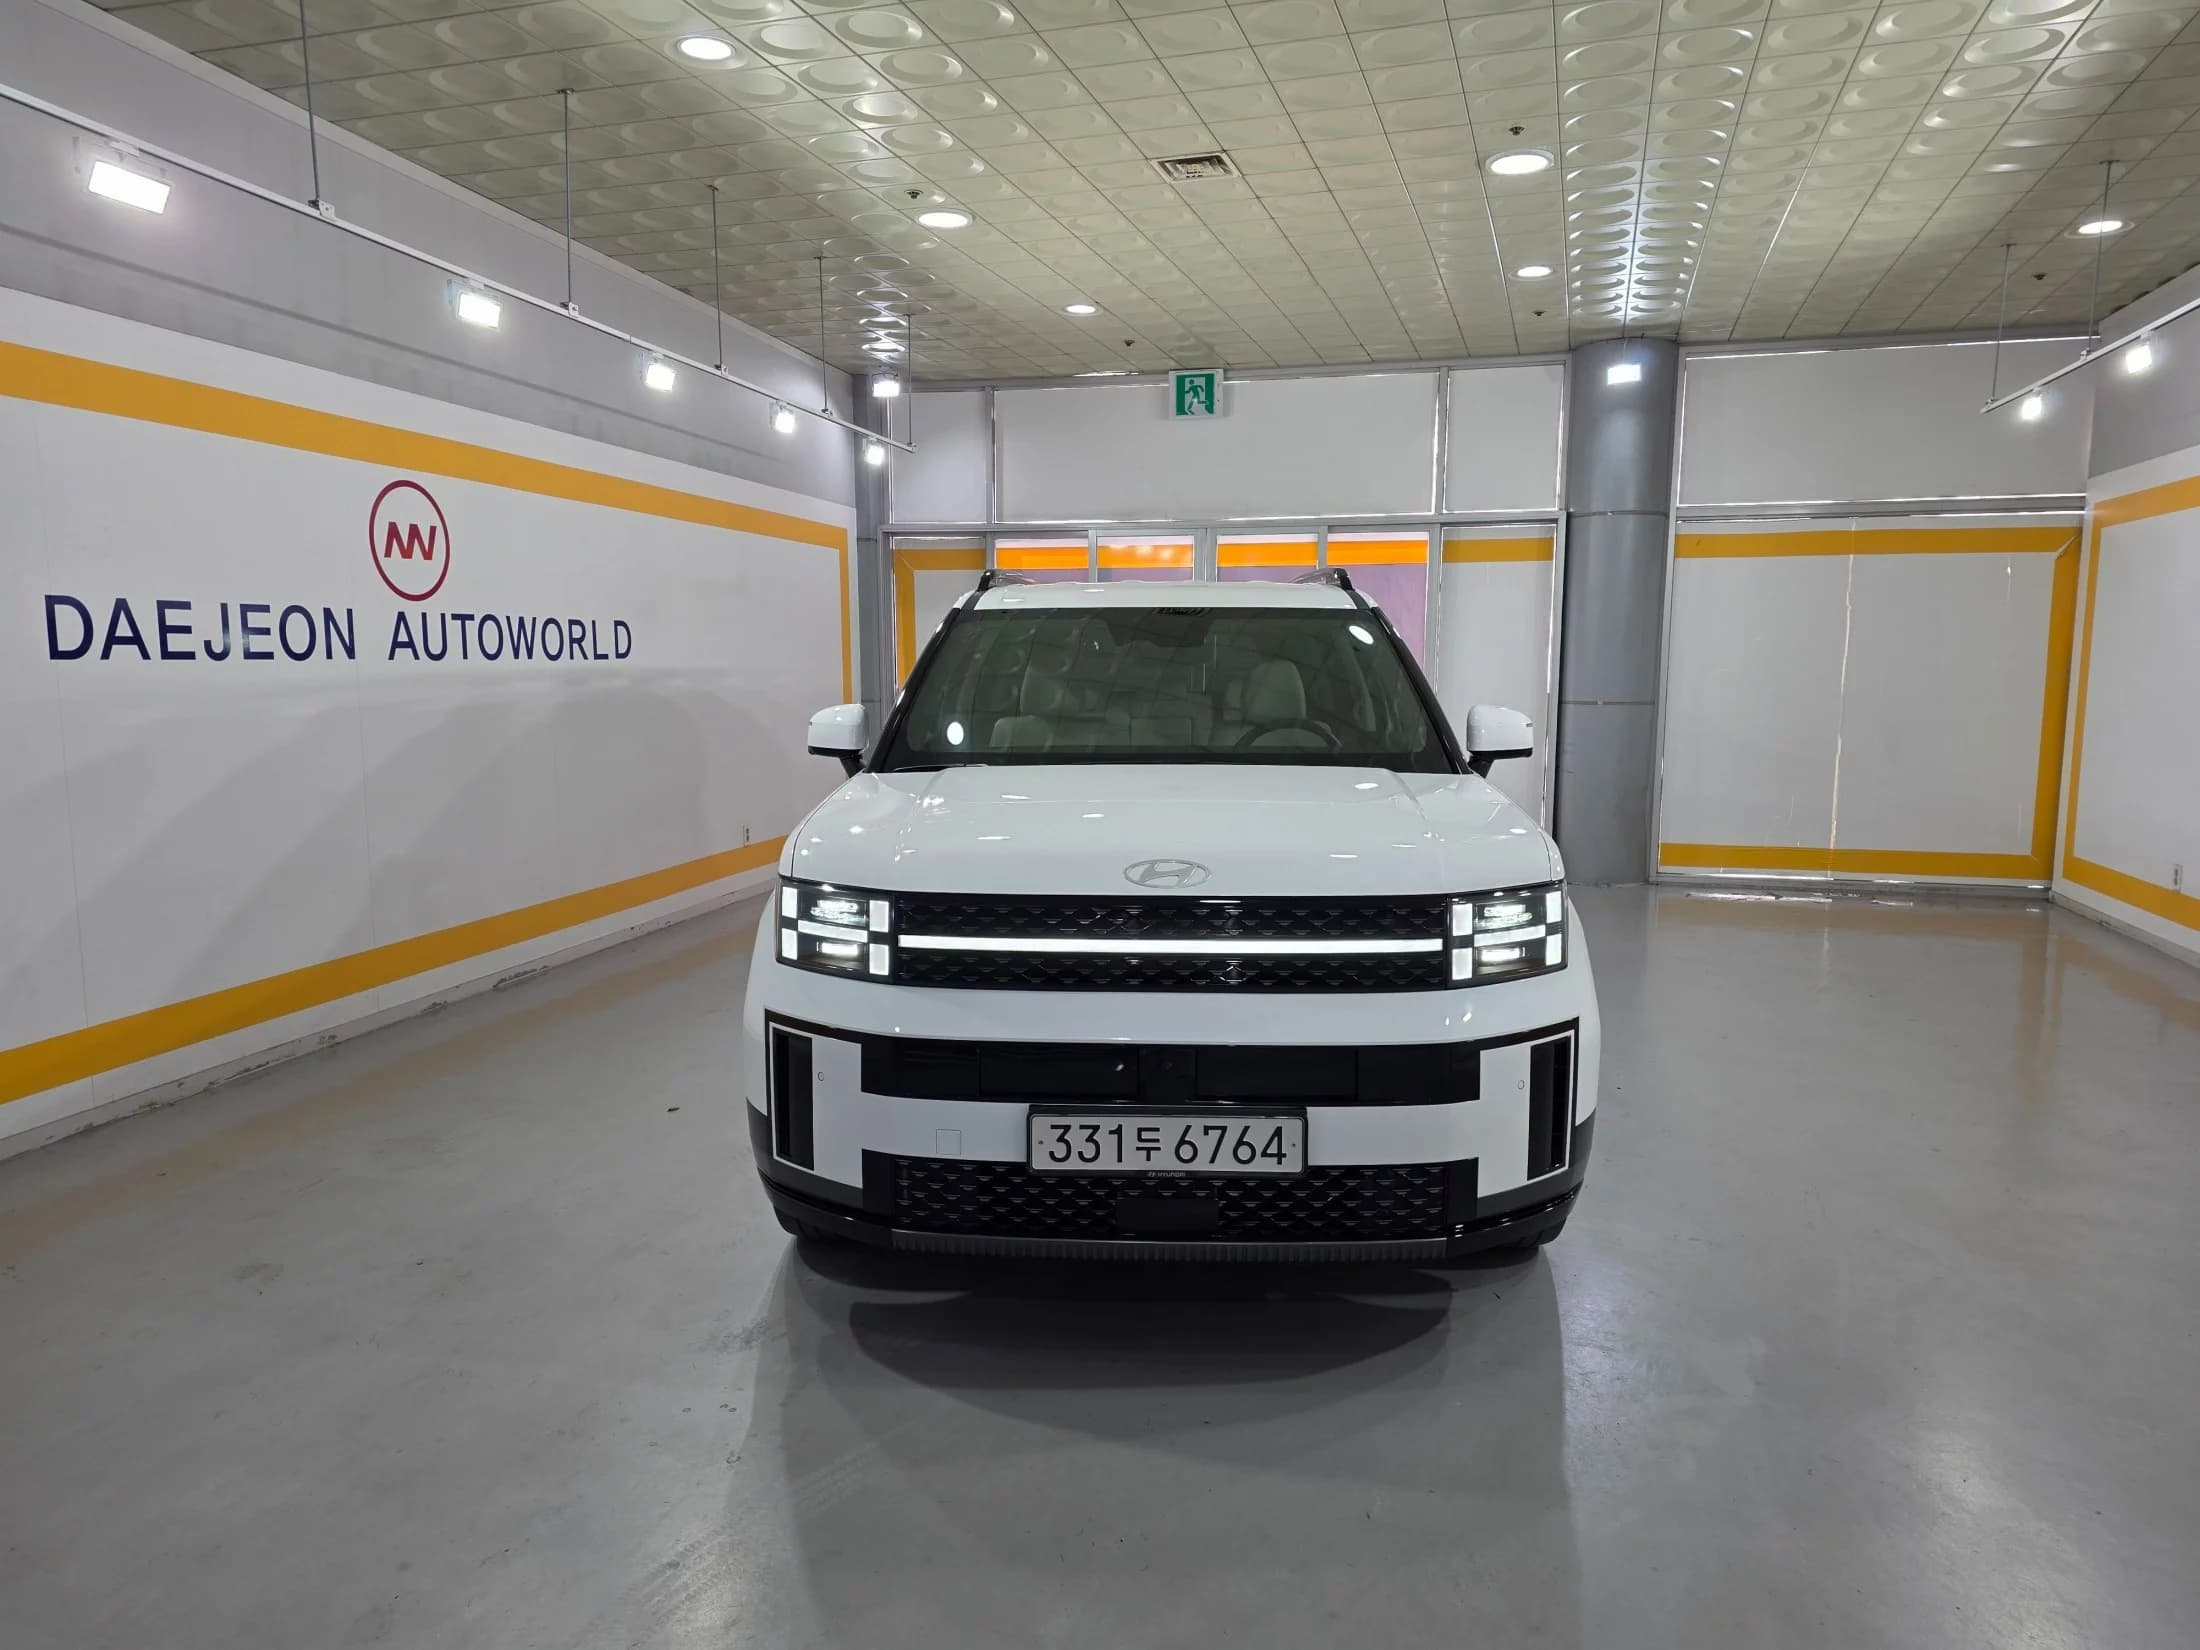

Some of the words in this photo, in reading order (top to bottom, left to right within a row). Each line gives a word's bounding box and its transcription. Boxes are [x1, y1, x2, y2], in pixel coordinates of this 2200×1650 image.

[44, 594, 356, 662] DAEJEON
[387, 610, 632, 662] AUTOWORLD
[1048, 1123, 1288, 1166] 331두6764
